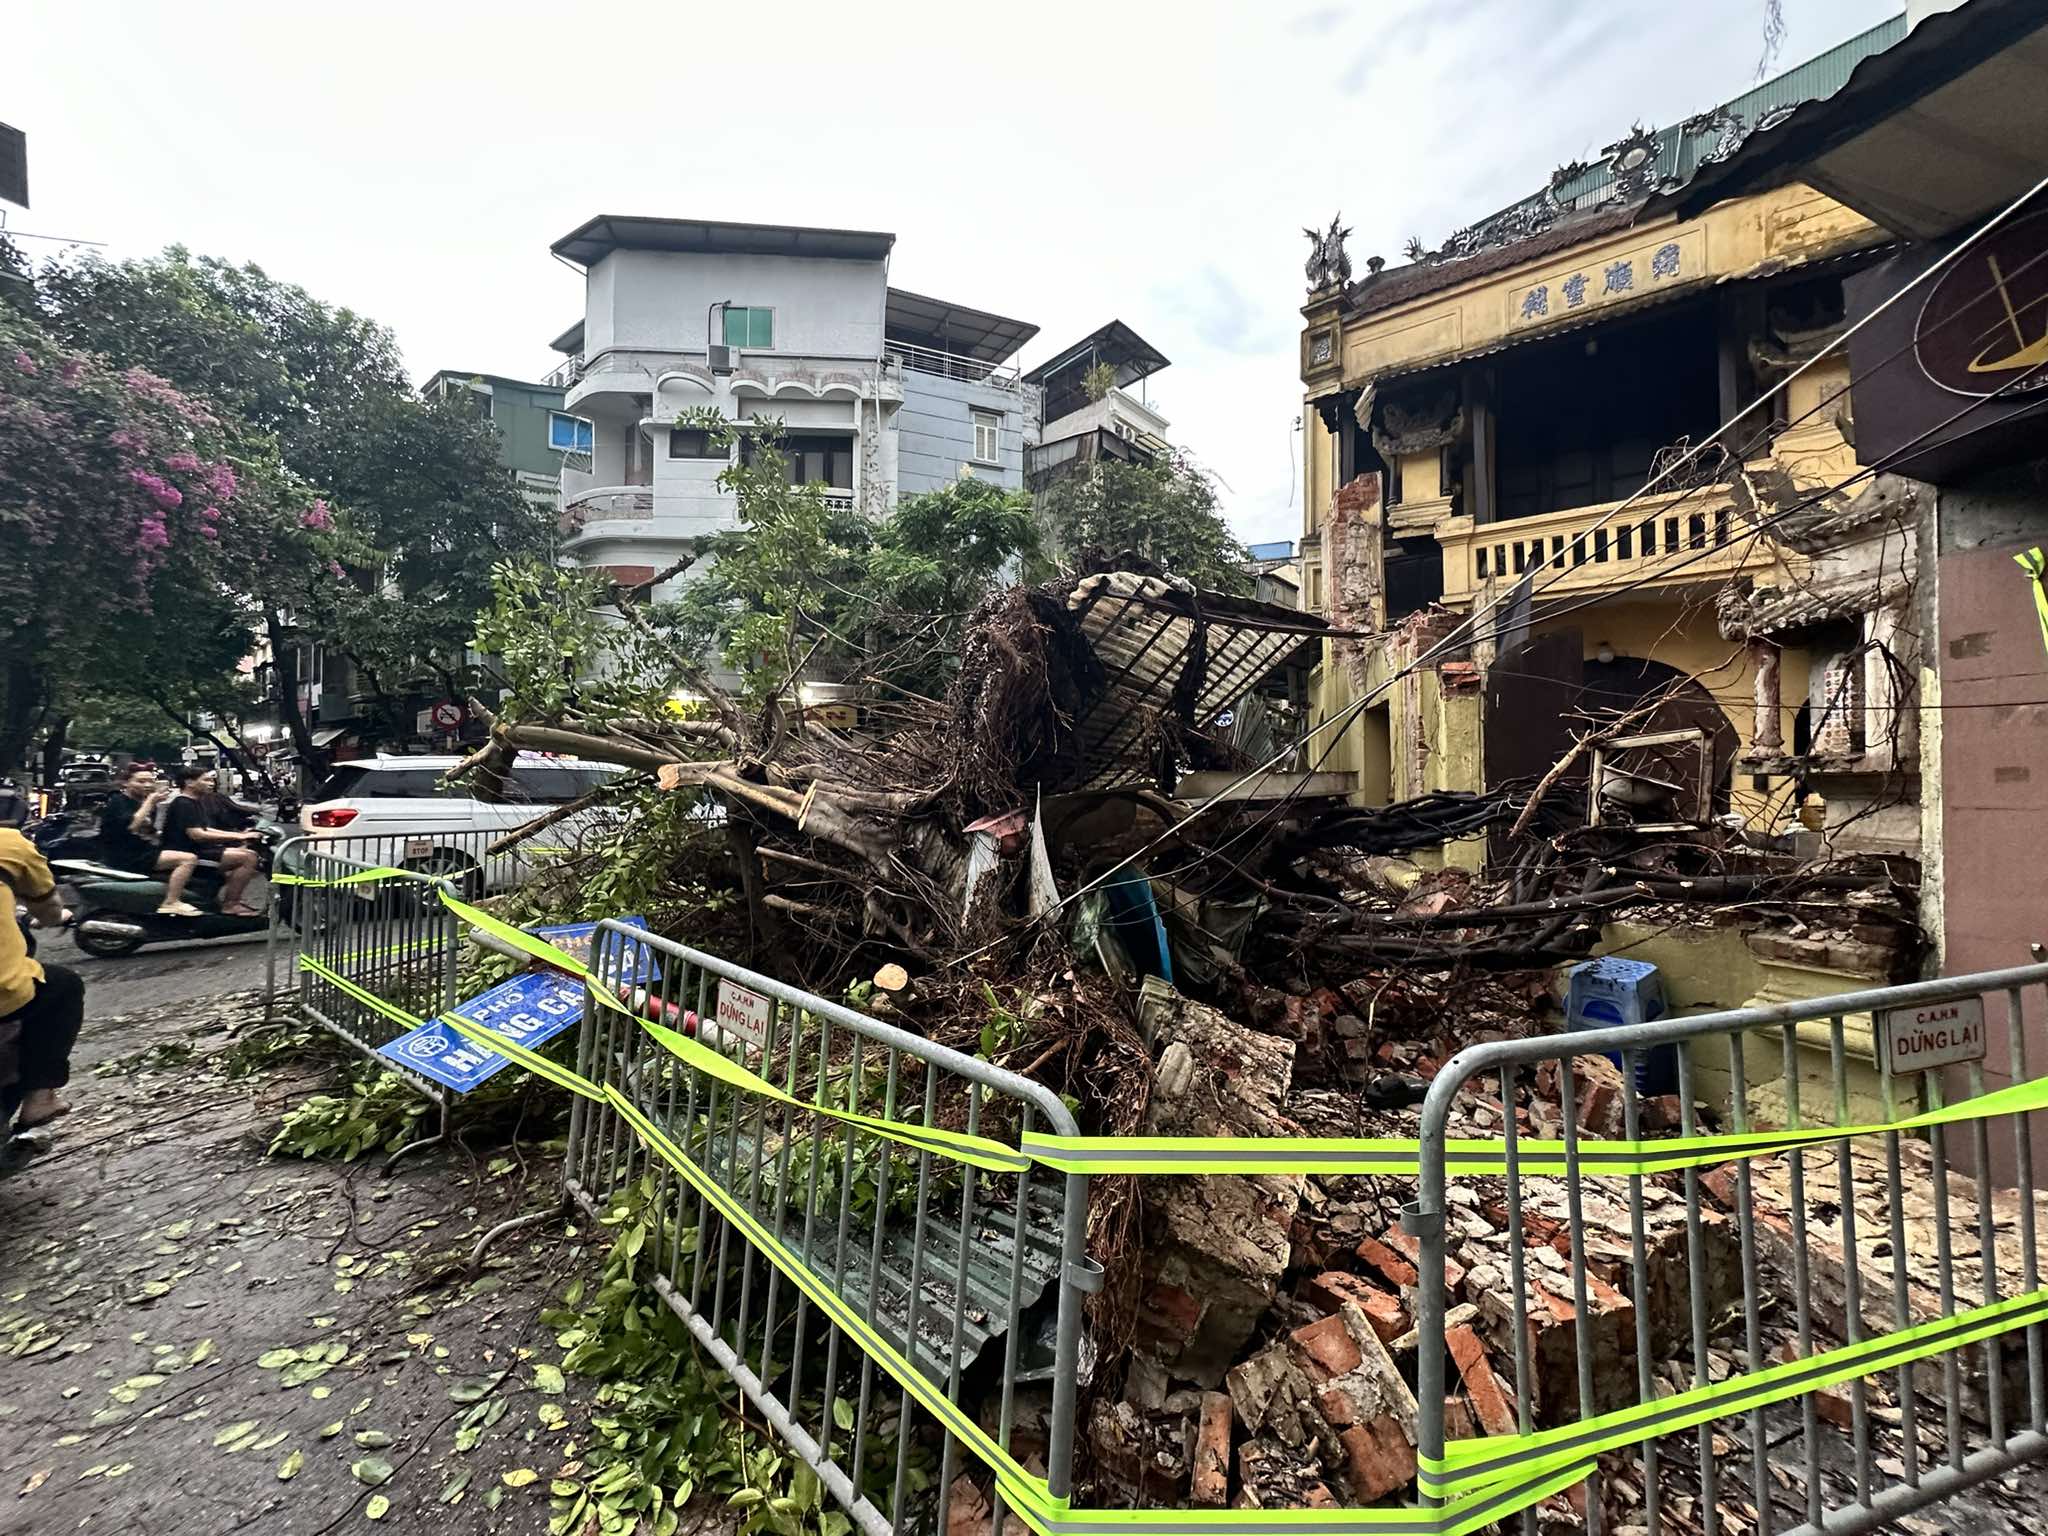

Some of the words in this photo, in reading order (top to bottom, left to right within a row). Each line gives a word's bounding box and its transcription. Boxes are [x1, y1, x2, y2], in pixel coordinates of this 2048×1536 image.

[412, 847, 429, 855] STOP
[747, 1015, 765, 1037] LẠI
[1897, 1028, 1948, 1056] DỪNG
